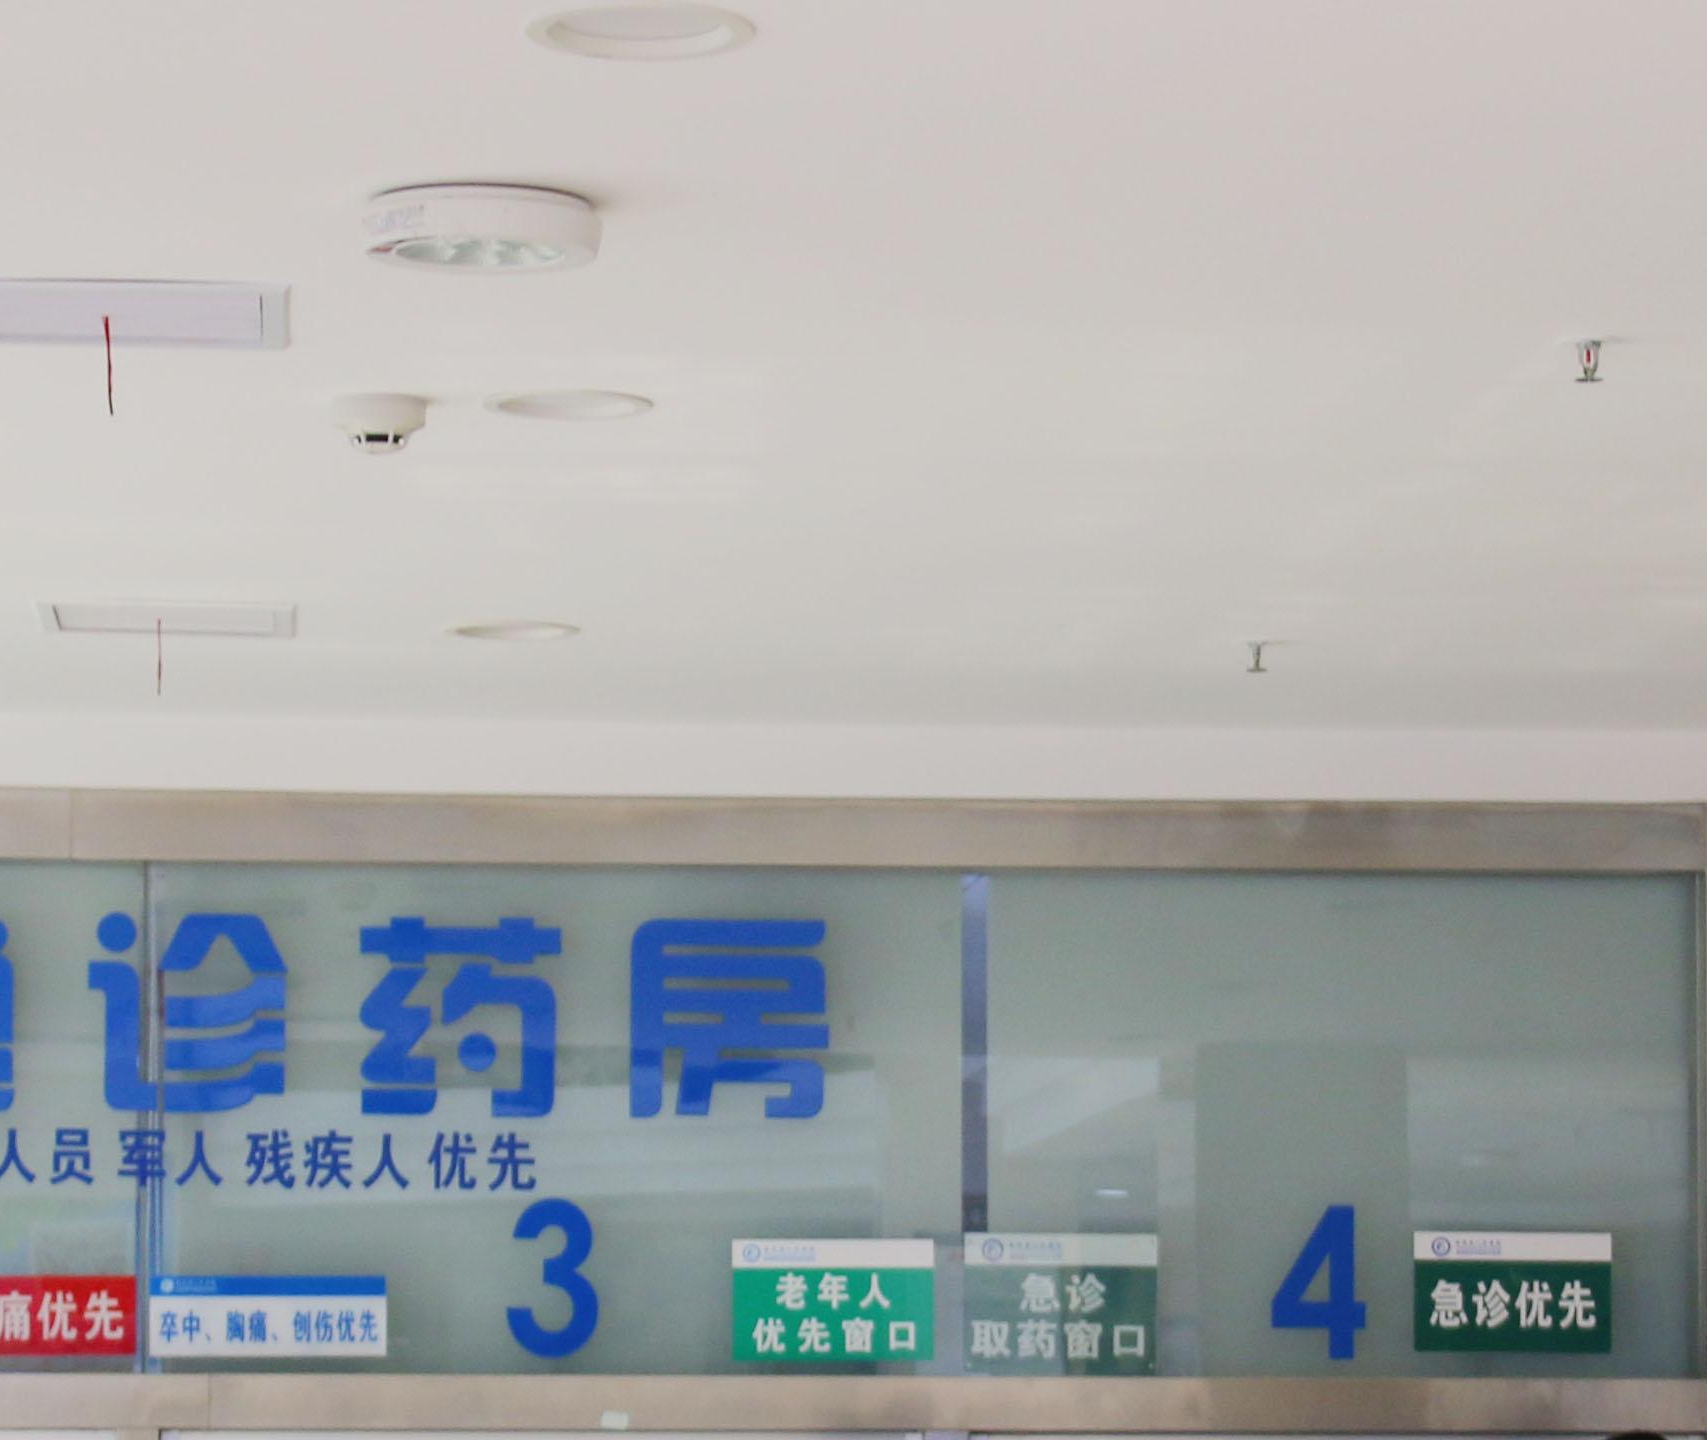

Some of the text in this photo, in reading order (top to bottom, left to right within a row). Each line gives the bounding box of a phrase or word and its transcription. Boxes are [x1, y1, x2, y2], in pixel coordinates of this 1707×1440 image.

[506, 1197, 600, 1360] 3
[775, 1271, 892, 1310] 老年人
[1019, 1272, 1107, 1314] 急诊
[1270, 1205, 1367, 1360] 4
[1429, 1279, 1597, 1330] 急诊优先
[751, 1316, 917, 1354] 优先窗口
[970, 1318, 1146, 1360] 取药窗口
